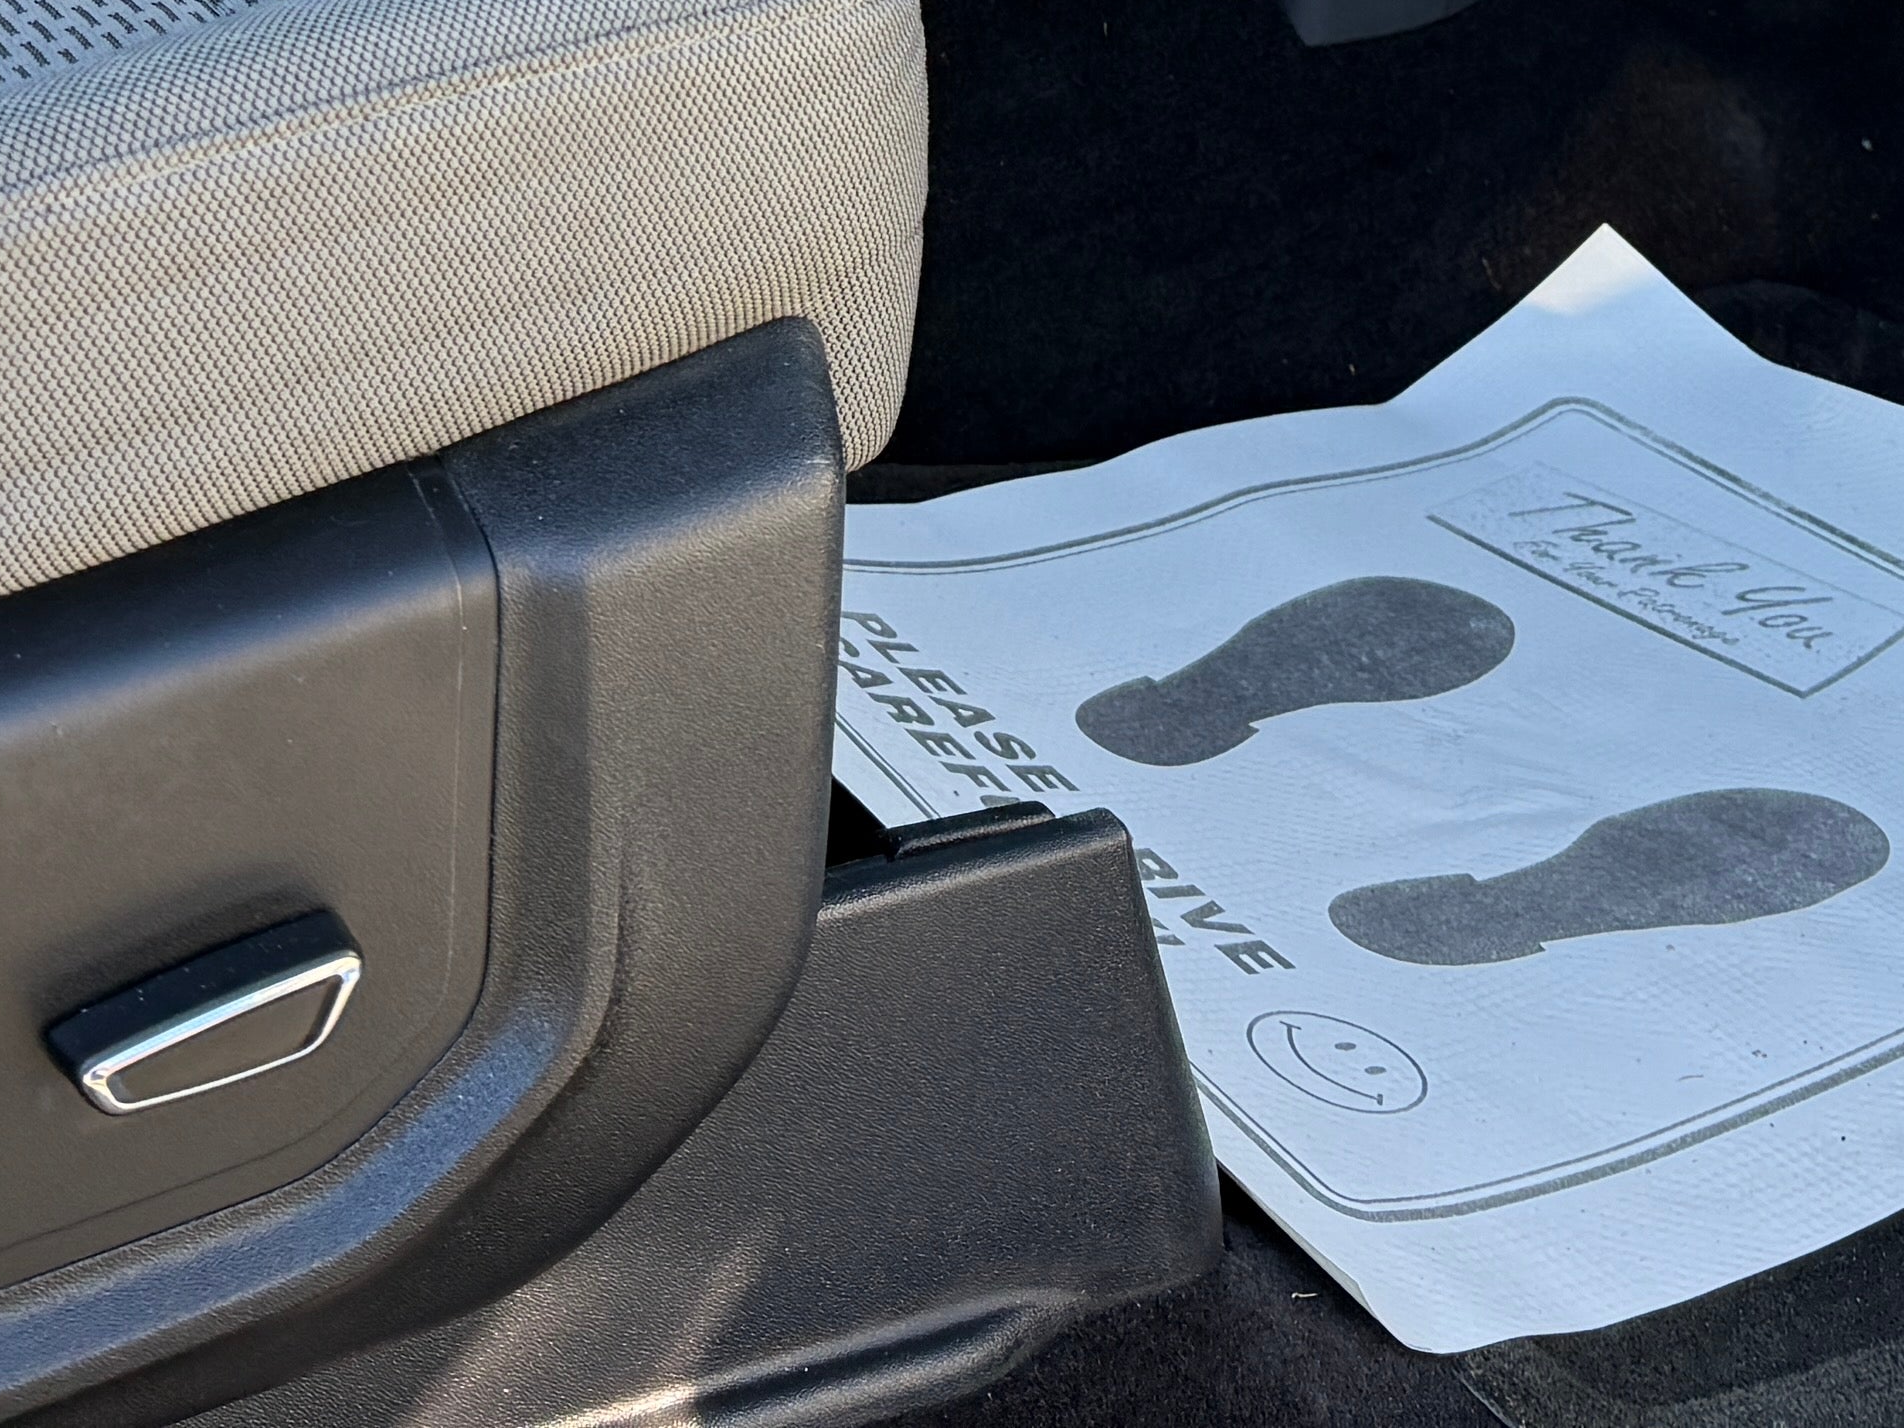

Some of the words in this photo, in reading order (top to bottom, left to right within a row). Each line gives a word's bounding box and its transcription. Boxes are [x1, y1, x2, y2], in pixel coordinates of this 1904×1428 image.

[1507, 491, 1750, 590] Thank
[1721, 585, 1834, 649] You
[1562, 561, 1619, 588] Your
[841, 611, 1081, 793] PLEASE
[1135, 847, 1297, 975] RIVE
